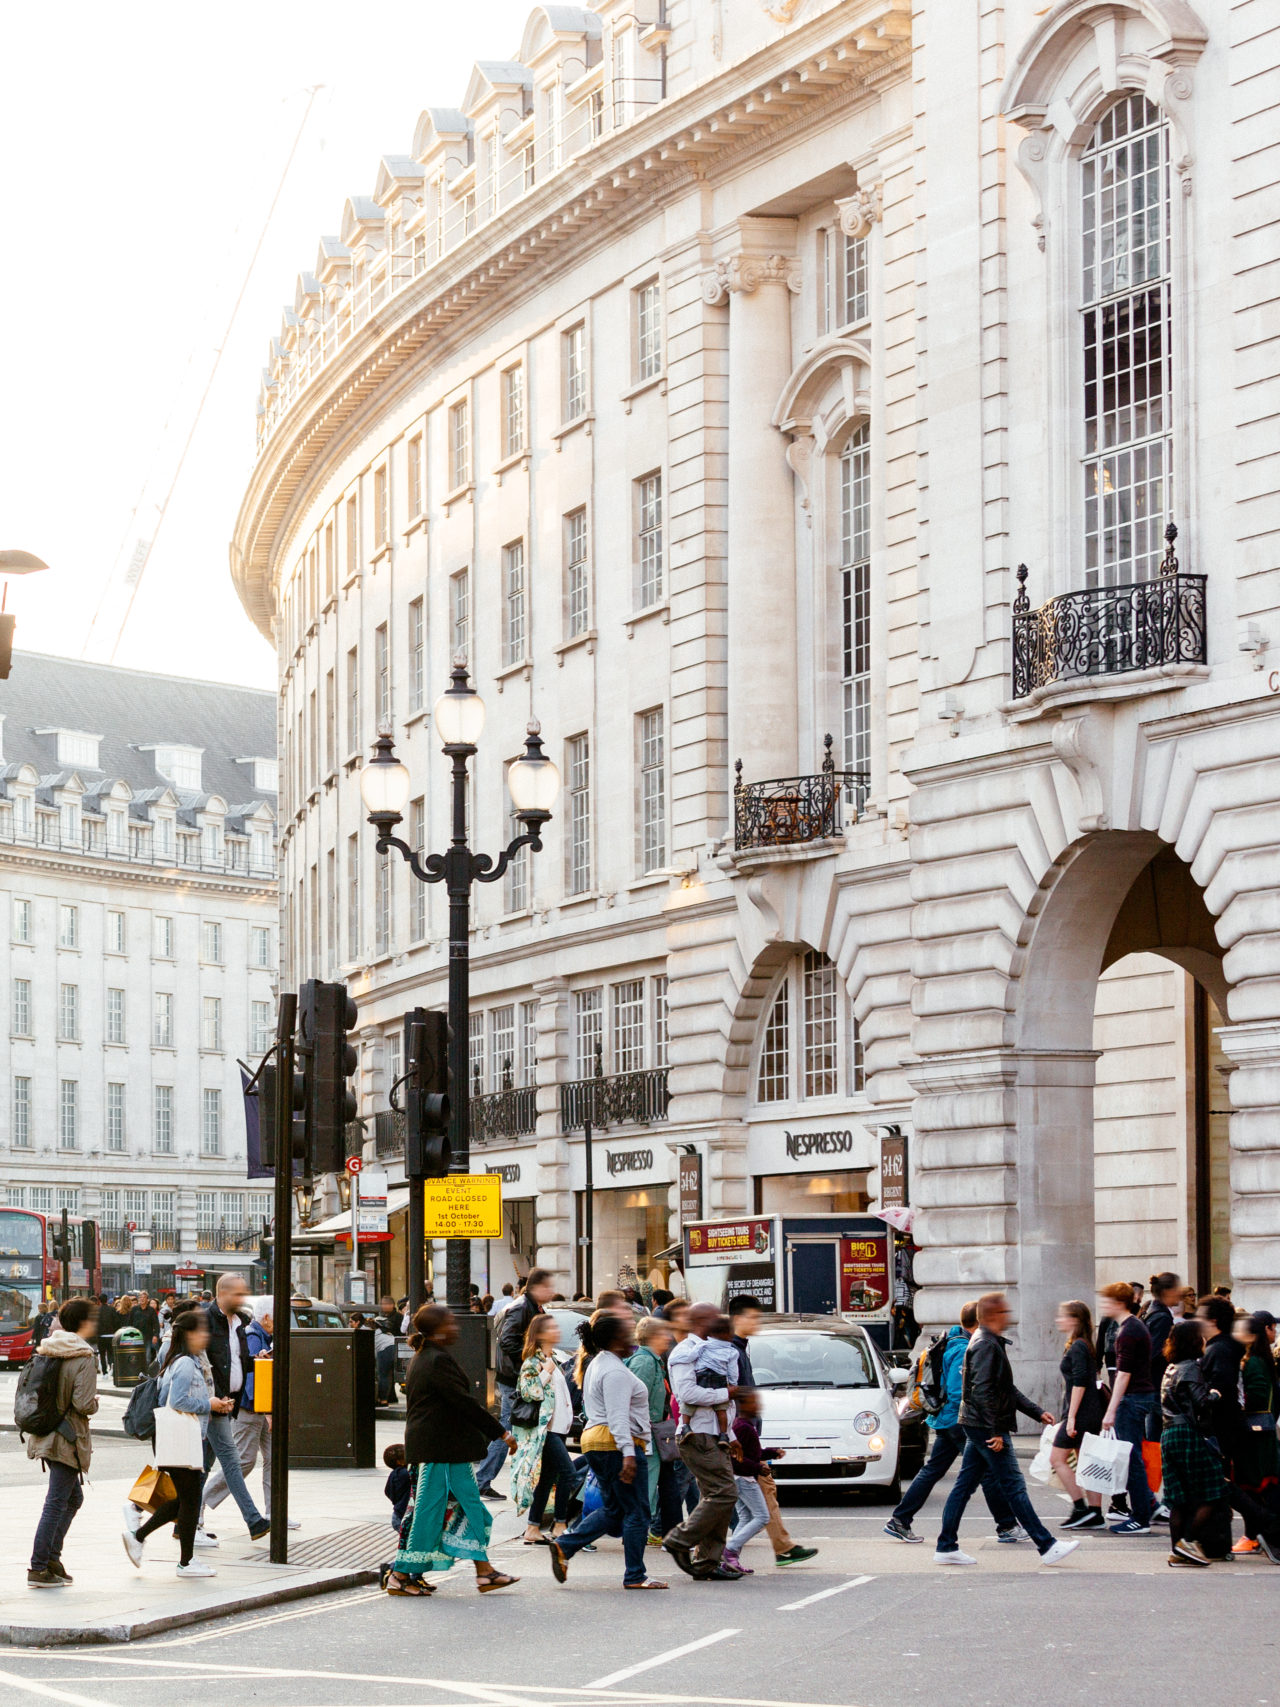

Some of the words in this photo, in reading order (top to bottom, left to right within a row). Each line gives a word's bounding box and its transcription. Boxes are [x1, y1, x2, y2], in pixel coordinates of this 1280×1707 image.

[784, 1130, 853, 1161] NESPRESSO
[349, 1159, 360, 1171] G
[605, 1149, 654, 1178] NESPRESSO
[882, 1154, 903, 1177] 54-62
[707, 1227, 735, 1238] SIGHTSEEING
[735, 1225, 750, 1236] TOURS
[707, 1237, 718, 1248] BUY
[718, 1236, 737, 1247] TICKETS
[737, 1234, 750, 1246] HERE
[851, 1242, 865, 1250] BIG
[14, 1264, 29, 1276] 139
[746, 1279, 751, 1287] OF
